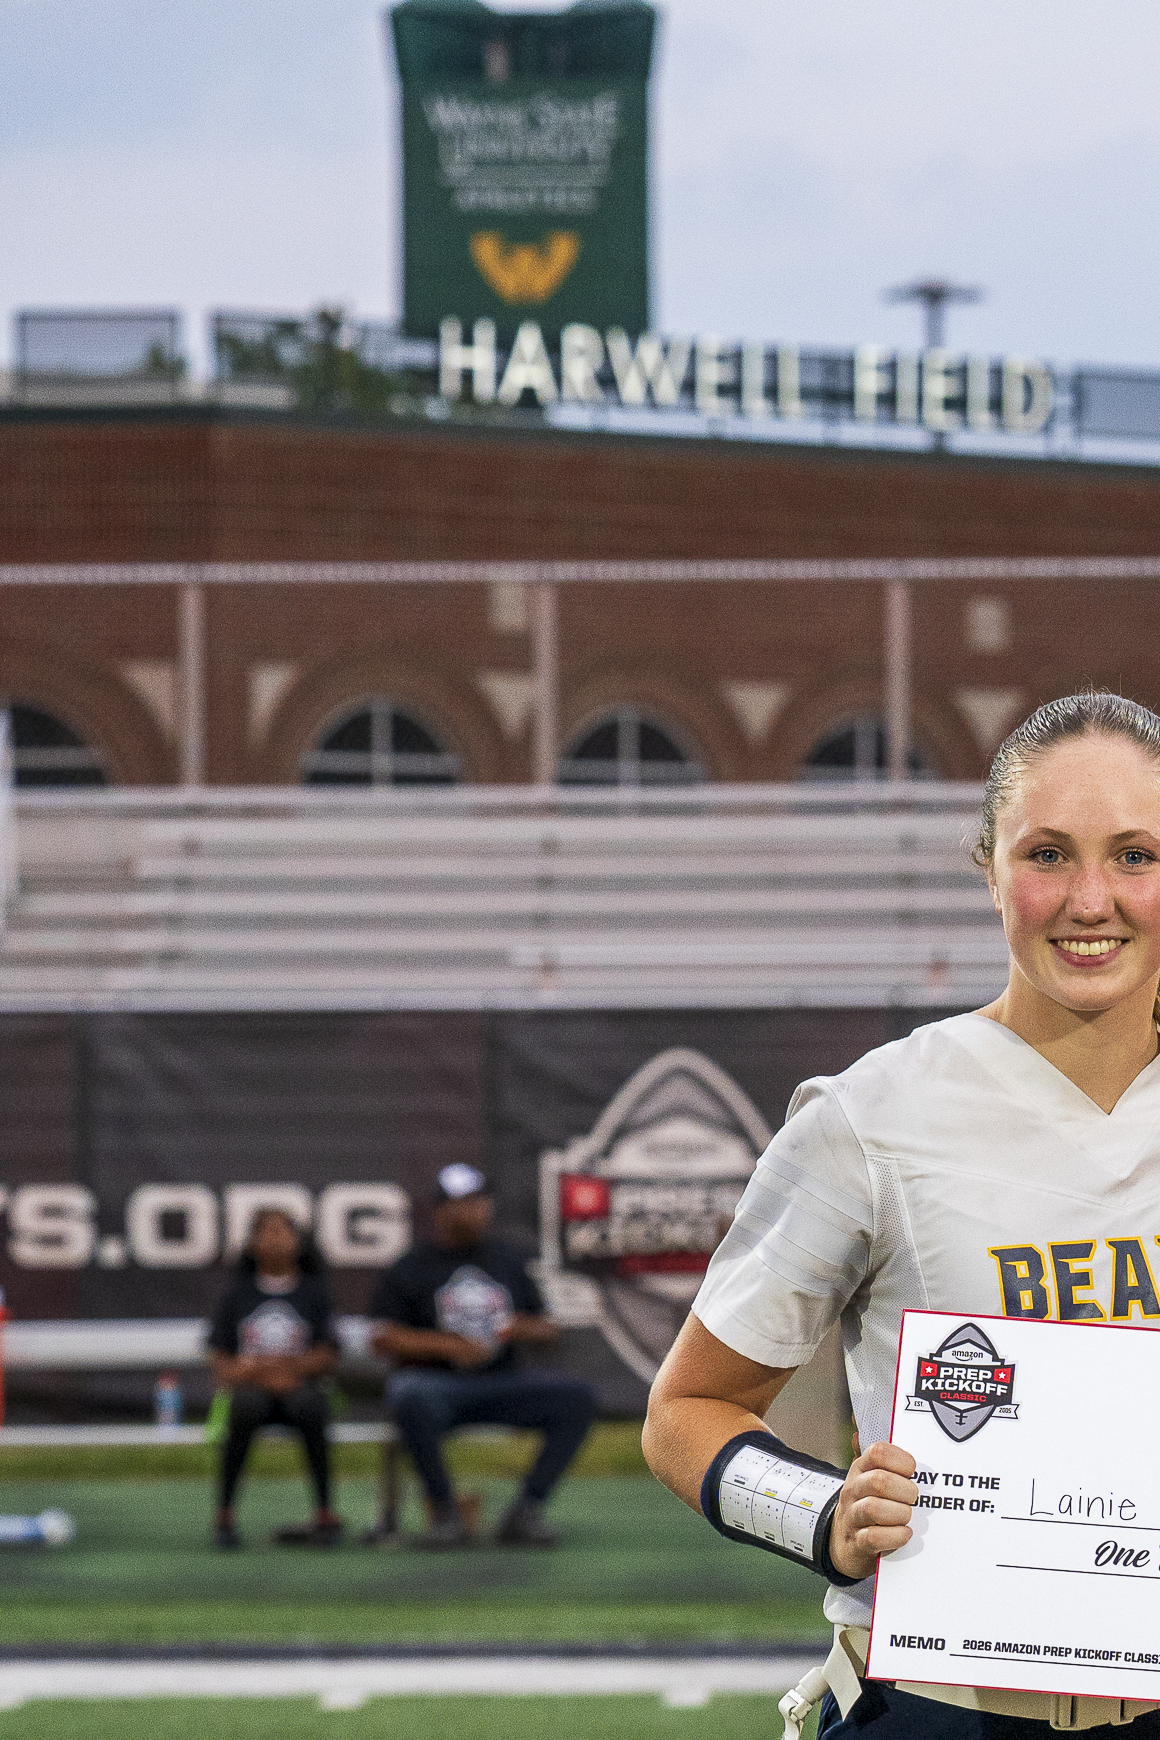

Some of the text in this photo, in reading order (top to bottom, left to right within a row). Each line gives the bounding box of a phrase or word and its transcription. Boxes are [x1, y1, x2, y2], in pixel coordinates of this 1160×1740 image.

[438, 315, 1055, 433] HARWELL FIELD
[0, 1182, 412, 1269] S.ORG
[951, 1350, 984, 1359] amazon
[939, 1366, 993, 1381] PREP
[920, 1378, 1008, 1396] KICKOFF
[940, 1391, 987, 1403] CLASSIC
[942, 1473, 964, 1487] TO
[968, 1475, 1000, 1490] THE
[969, 1499, 995, 1513] OF:
[1029, 1478, 1138, 1522] Lainie
[1094, 1540, 1151, 1568] One
[889, 1633, 946, 1651] MEMO
[962, 1639, 993, 1652] 2026
[993, 1641, 1042, 1657] AMAZON
[1043, 1645, 1073, 1659] PREP
[1074, 1647, 1123, 1662] KICKOFF
